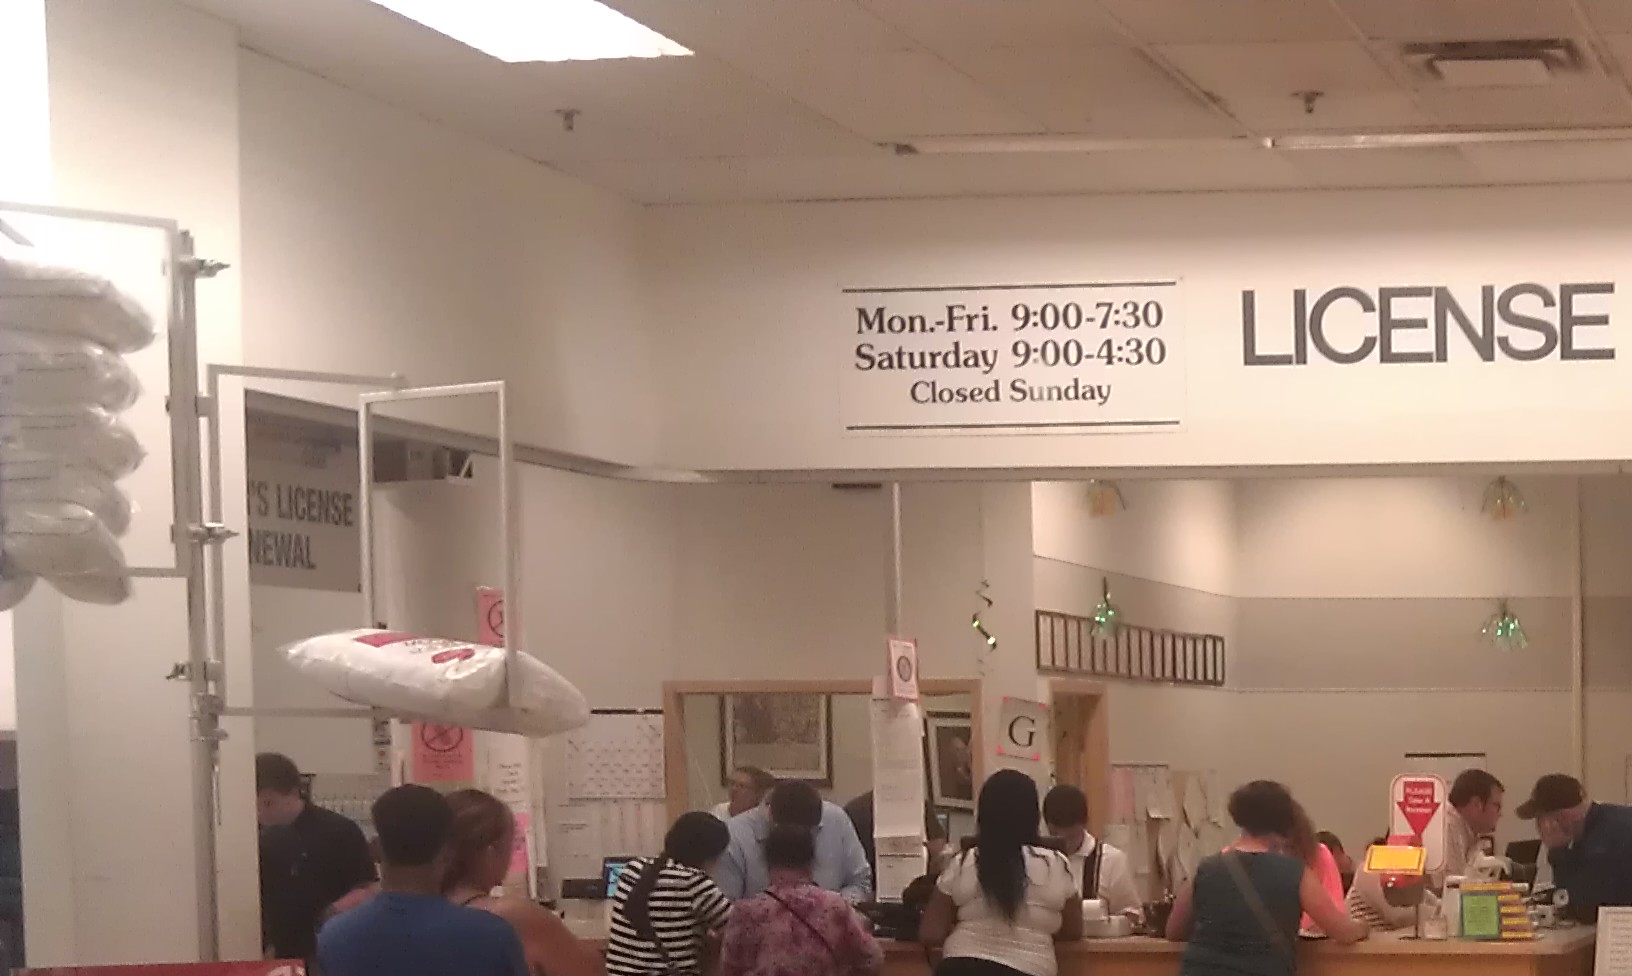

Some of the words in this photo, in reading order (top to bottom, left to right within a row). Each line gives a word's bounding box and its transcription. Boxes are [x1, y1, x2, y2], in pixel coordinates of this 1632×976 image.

[855, 304, 998, 335] Mon.-Fri.
[1011, 300, 1164, 331] 9:00-7:30
[1241, 282, 1616, 366] LICENSE
[854, 341, 998, 375] Saturday
[1011, 337, 1167, 368] 9:00-4:30
[910, 379, 1000, 404] Closed
[1009, 377, 1112, 406] Sunday
[277, 484, 353, 527] LICENSE
[249, 528, 317, 570] NEWAL
[1008, 715, 1036, 748] G
